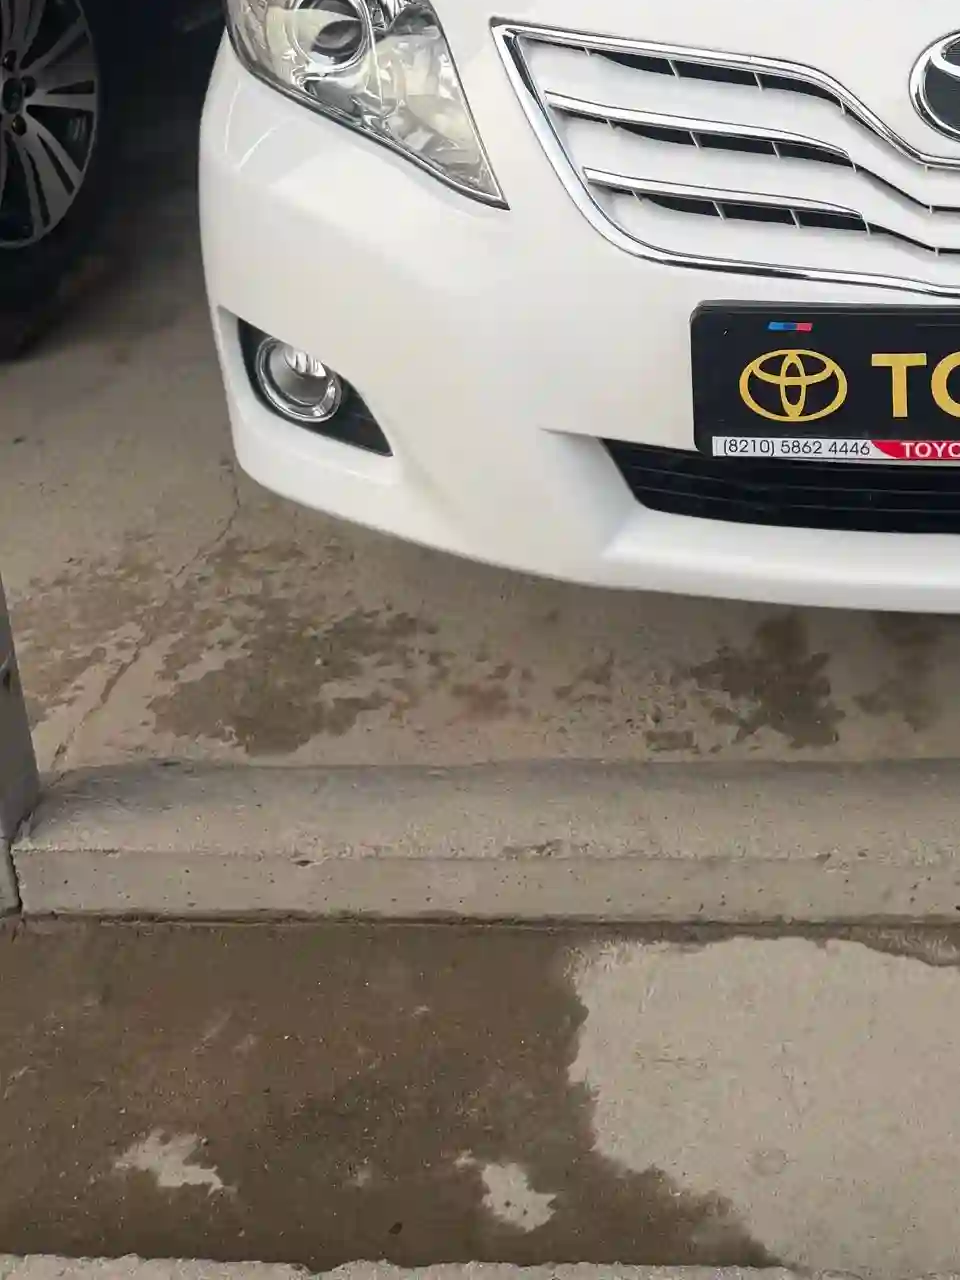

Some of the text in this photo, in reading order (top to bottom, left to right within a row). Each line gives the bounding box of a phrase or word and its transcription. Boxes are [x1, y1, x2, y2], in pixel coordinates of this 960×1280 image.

[723, 439, 870, 456] (8210) 5862 4446
